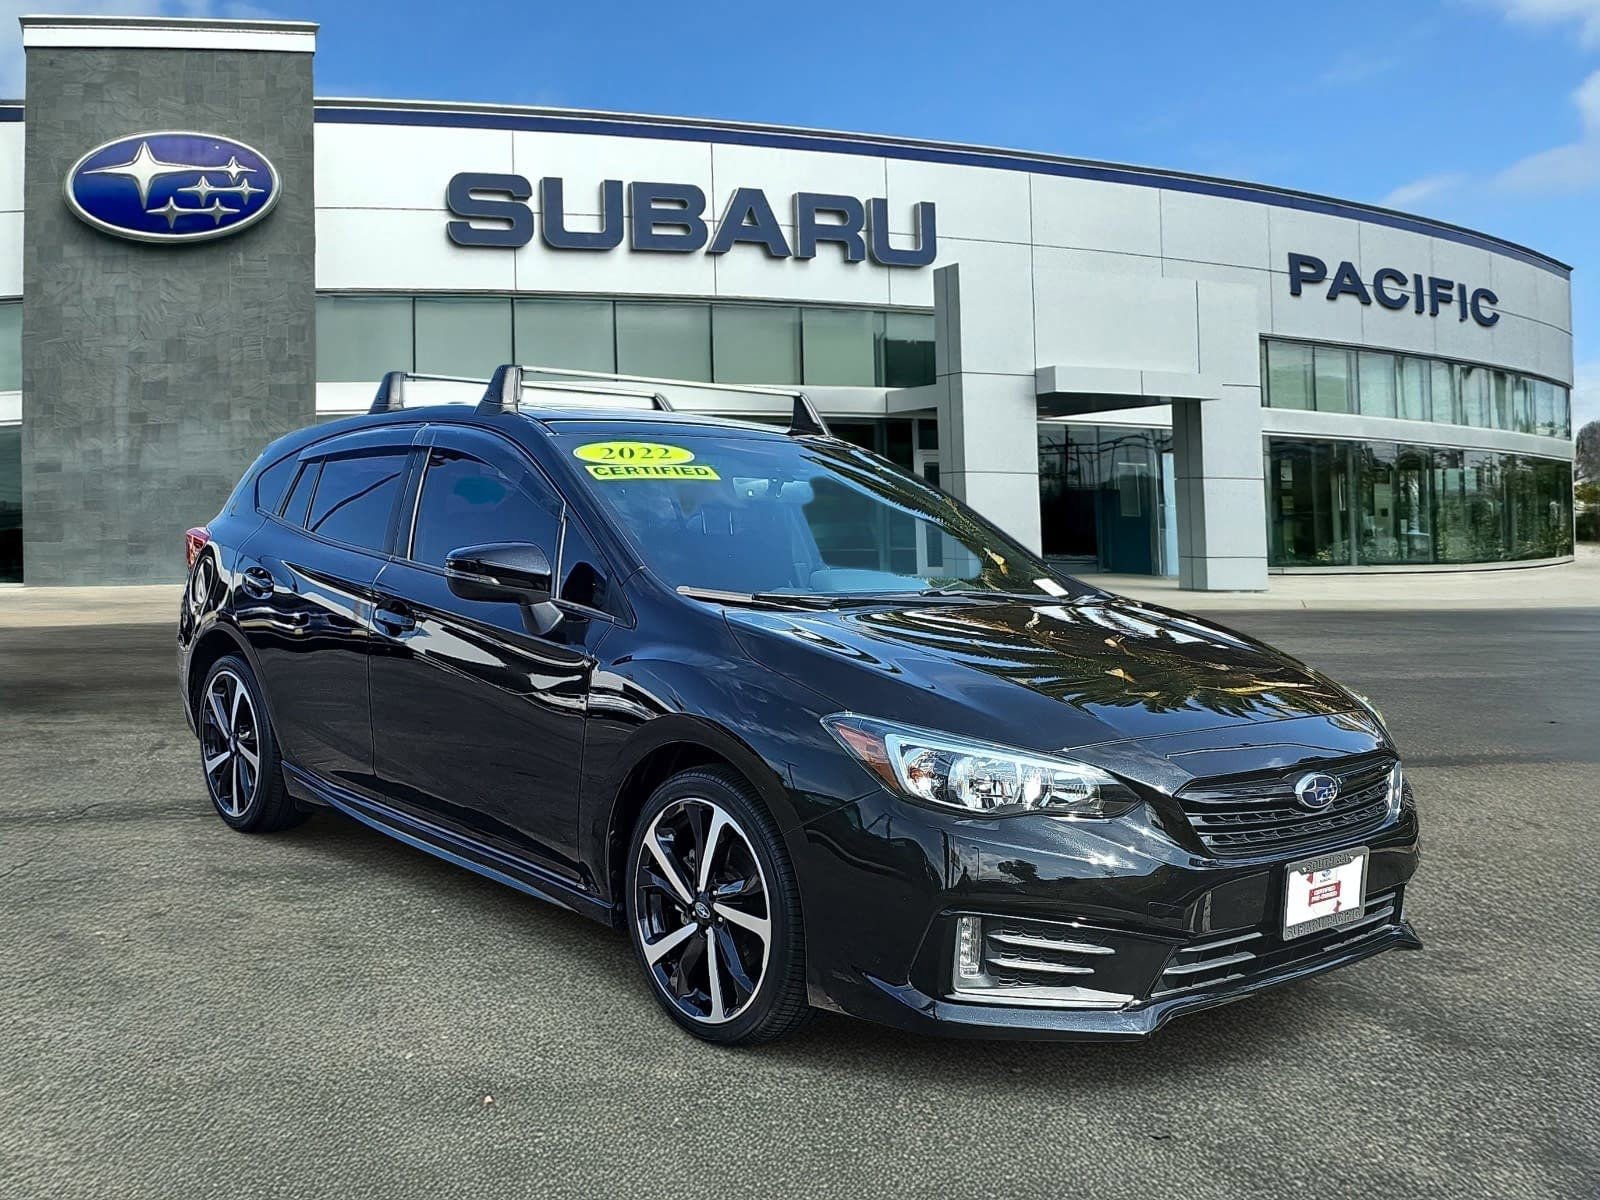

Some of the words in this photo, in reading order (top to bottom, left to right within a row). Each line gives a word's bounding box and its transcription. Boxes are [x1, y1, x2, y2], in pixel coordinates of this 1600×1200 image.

[446, 171, 937, 268] SUBARU
[1287, 251, 1500, 327] PACIFIC
[593, 466, 709, 476] CERTIFIED
[600, 447, 673, 460] 2022
